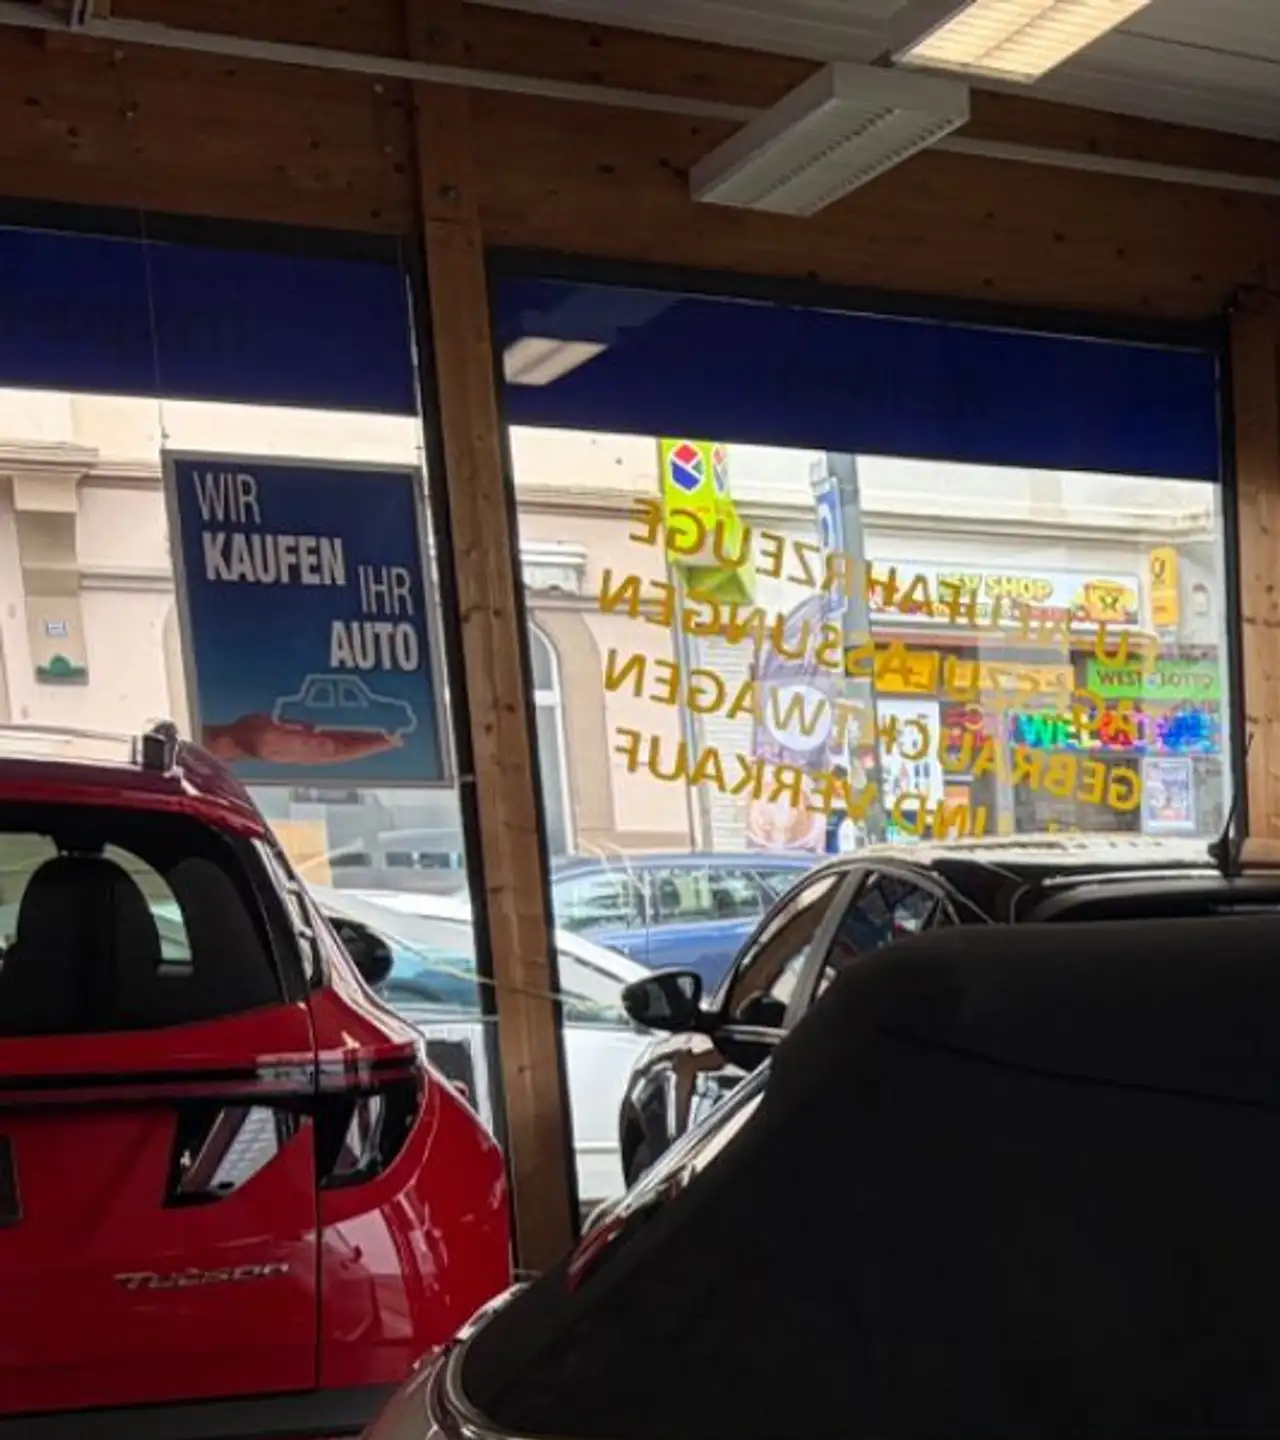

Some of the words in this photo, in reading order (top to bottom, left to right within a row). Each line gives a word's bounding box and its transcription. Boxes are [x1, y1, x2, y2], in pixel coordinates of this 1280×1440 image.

[193, 470, 261, 524] WIR
[202, 530, 347, 586] KAUFEN
[357, 564, 414, 616] IHR
[329, 620, 418, 671] AUTO
